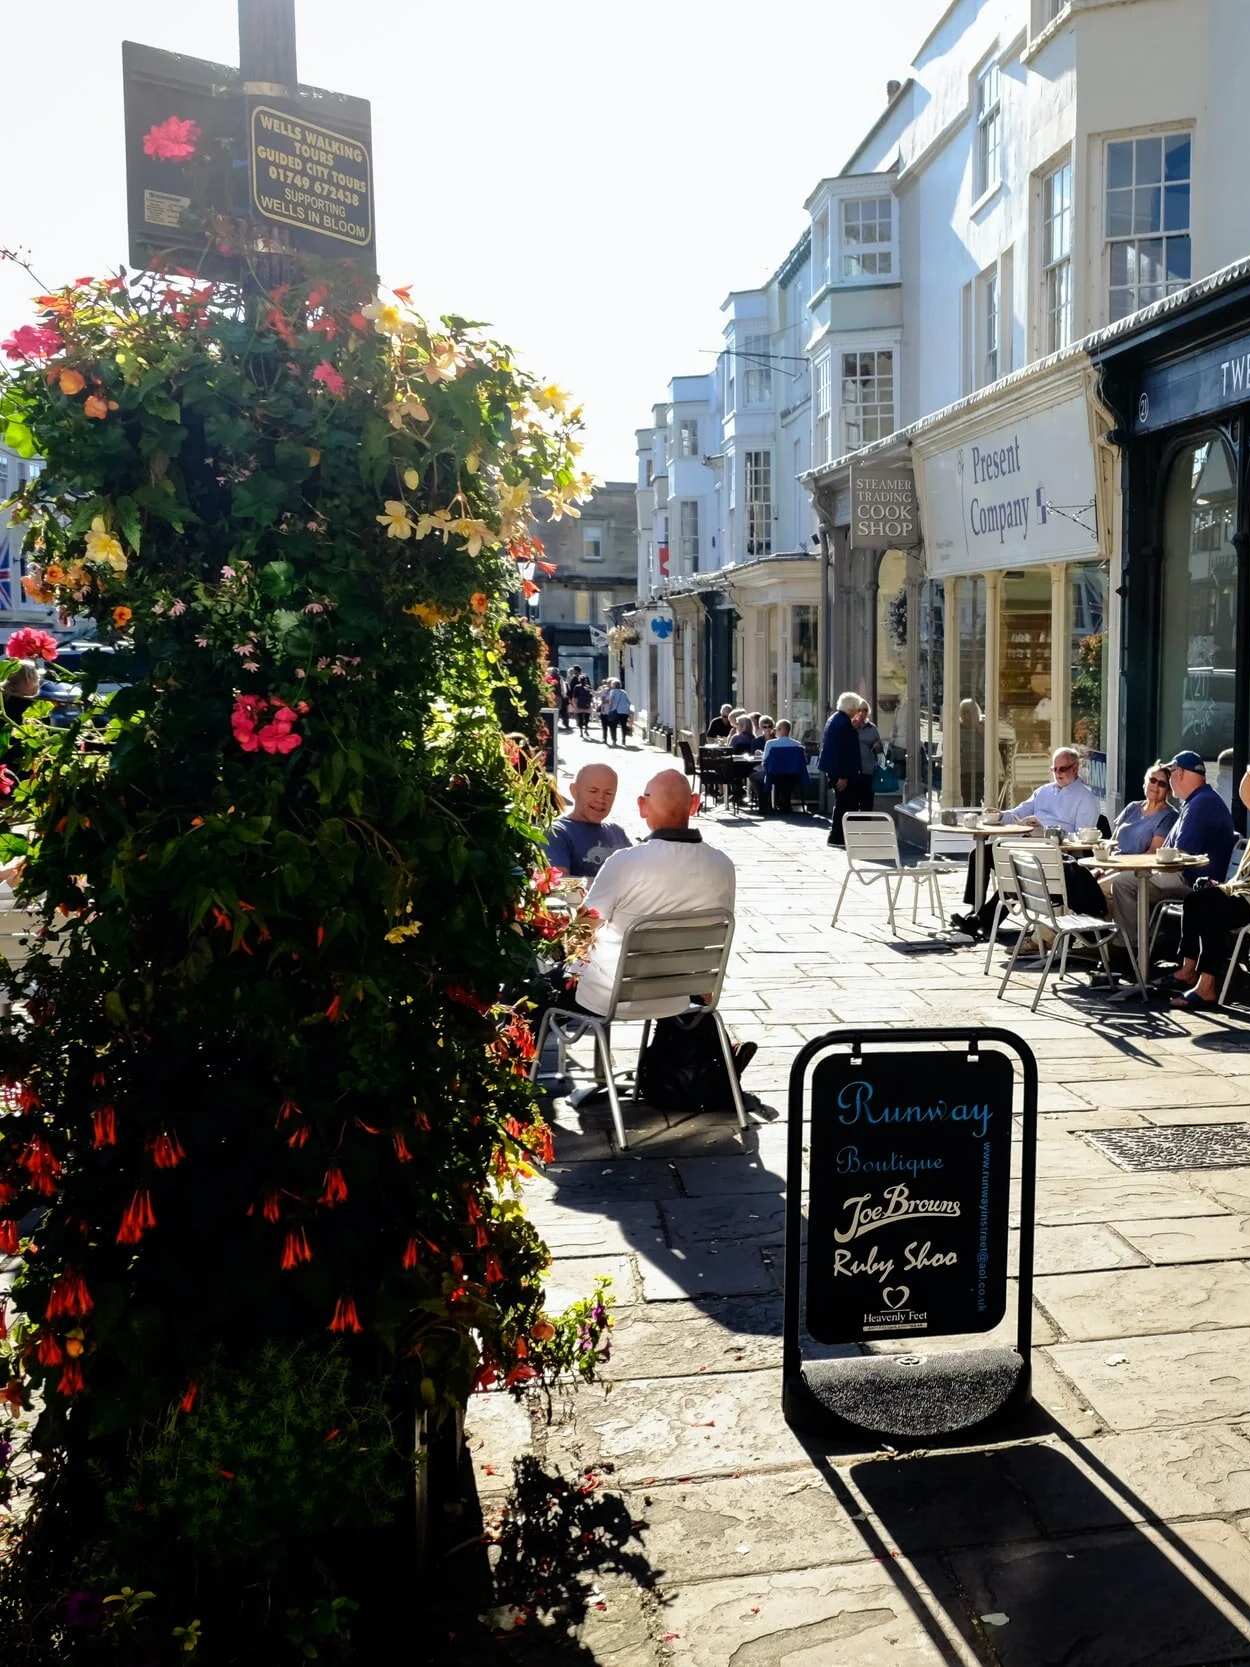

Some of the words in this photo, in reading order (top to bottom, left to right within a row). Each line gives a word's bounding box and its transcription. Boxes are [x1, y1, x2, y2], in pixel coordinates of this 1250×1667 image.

[259, 114, 301, 140] WELLS
[305, 130, 362, 162] WALKING
[294, 142, 334, 166] TOURS
[256, 145, 302, 170] GUIDED
[306, 162, 329, 180] CITY
[332, 170, 366, 193] TOURS
[268, 166, 310, 190] 01749
[314, 180, 360, 206] 672438
[260, 195, 305, 219] WELLS
[308, 210, 320, 224] IN
[324, 216, 366, 238] BLOOM
[284, 188, 346, 218] SUPPORTING
[972, 433, 1020, 484] Present
[856, 478, 912, 490] STEAMER
[856, 492, 912, 502] TRADING
[858, 504, 912, 520] COOK
[858, 521, 912, 536] SHOP
[970, 496, 1030, 544] Company
[837, 1080, 994, 1138] Runway
[836, 1146, 944, 1178] Boutique
[976, 1141, 990, 1312] www.runwayinstreet@aol.co.uk
[834, 1246, 894, 1283] Ruby
[904, 1240, 958, 1271] Shoo
[864, 1312, 906, 1324] Heavenly
[908, 1310, 928, 1320] Feet
